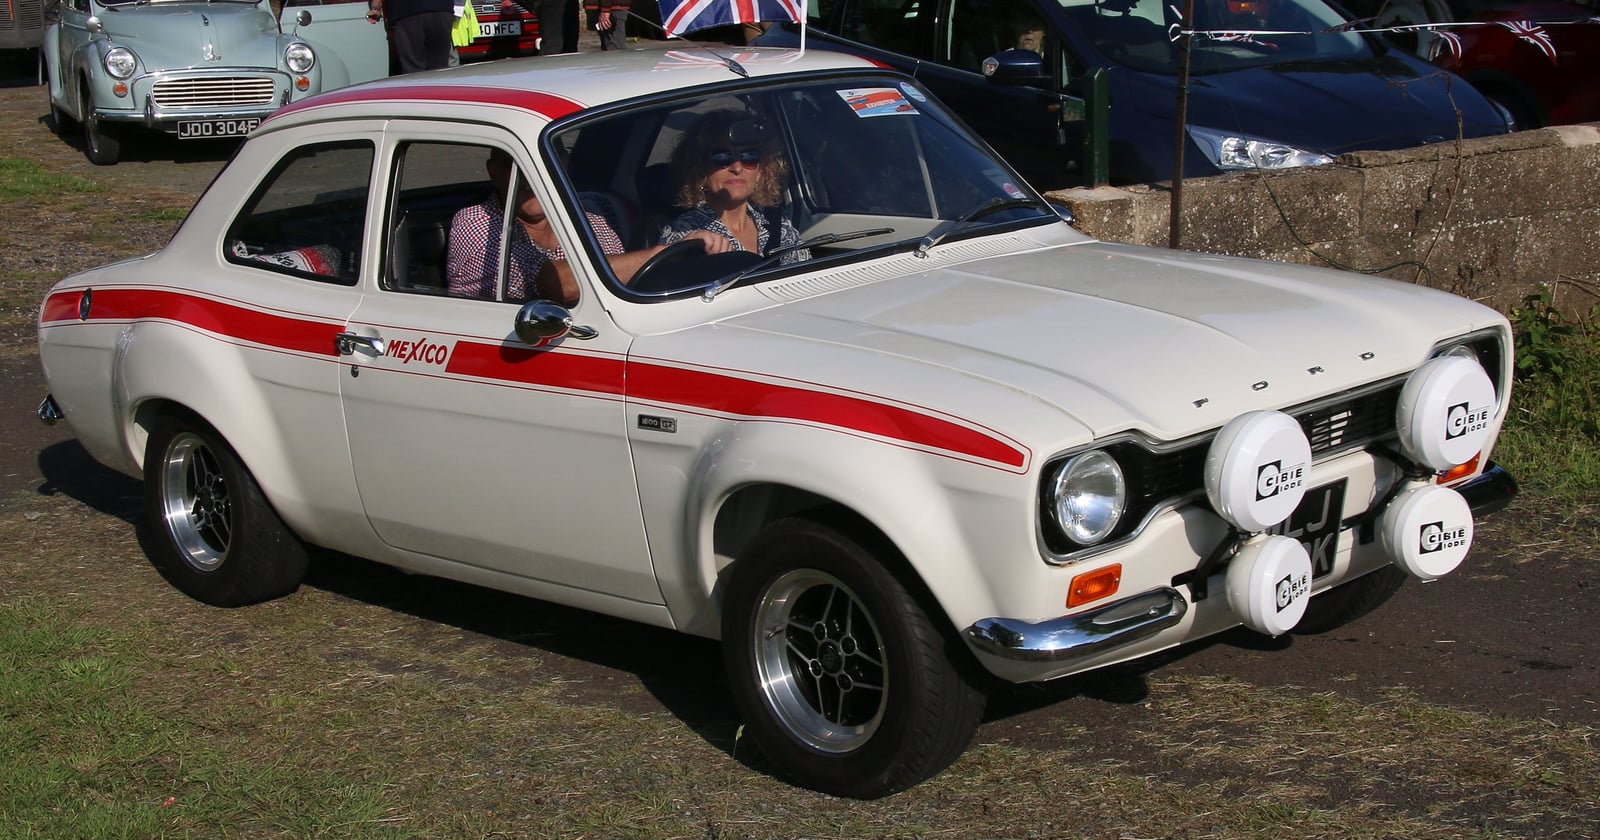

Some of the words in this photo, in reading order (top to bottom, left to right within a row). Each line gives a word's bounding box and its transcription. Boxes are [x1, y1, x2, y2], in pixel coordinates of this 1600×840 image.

[181, 122, 212, 137] JDO
[385, 337, 448, 365] MEXICO
[1193, 351, 1375, 408] FORD
[1455, 410, 1488, 427] CIBIE
[1467, 421, 1488, 433] IODE
[1266, 467, 1303, 487] CIBIE
[1279, 479, 1303, 492] IODE
[1428, 528, 1465, 543] CIBIE
[1443, 539, 1466, 549] IODE
[1282, 574, 1307, 599] CIBIE
